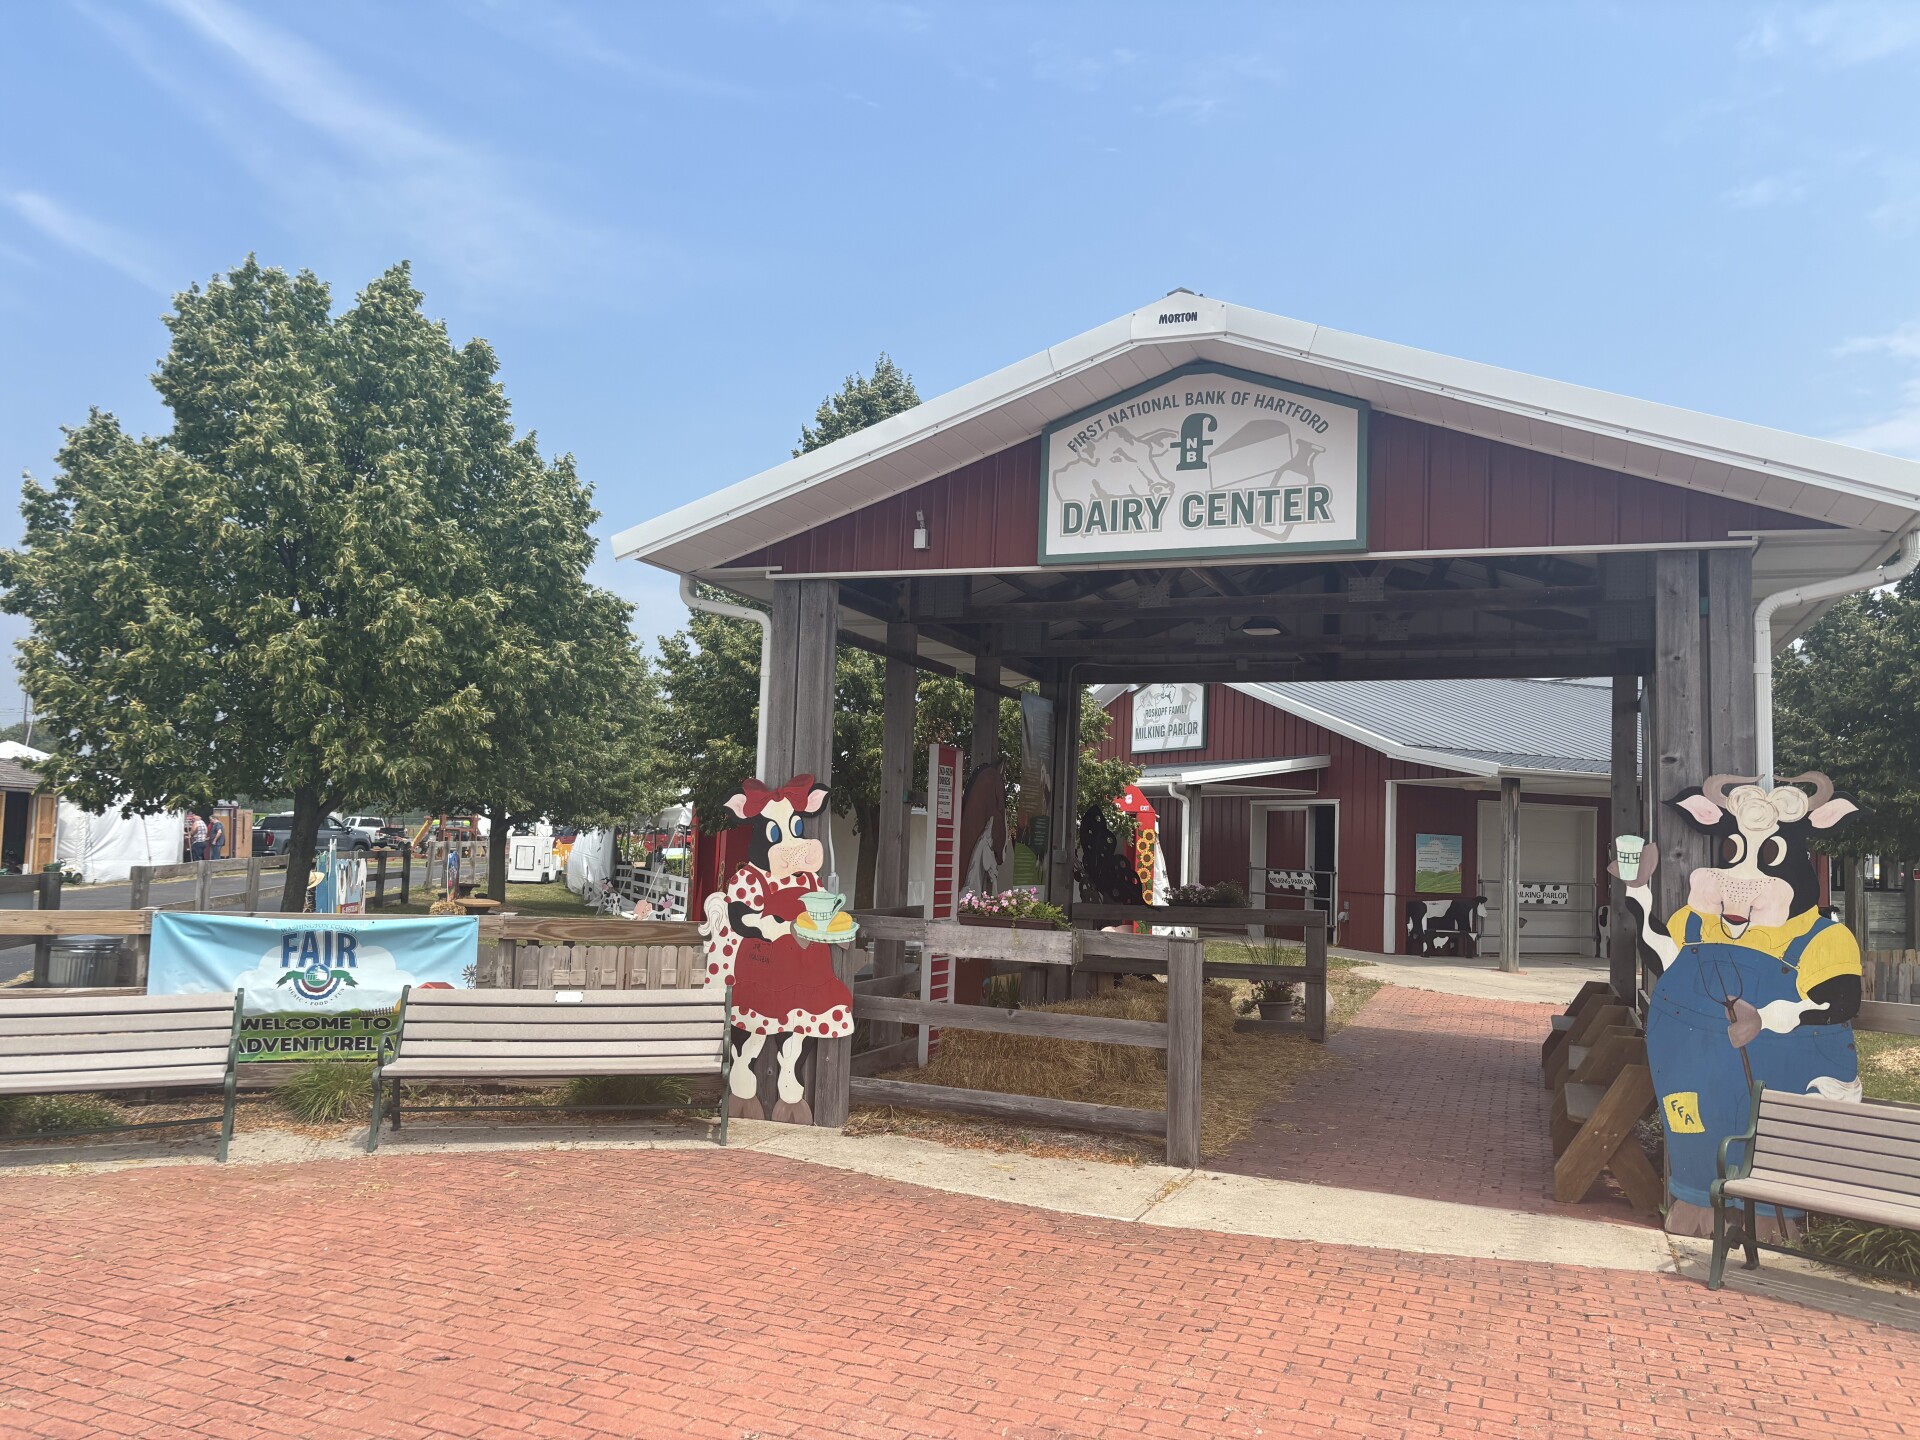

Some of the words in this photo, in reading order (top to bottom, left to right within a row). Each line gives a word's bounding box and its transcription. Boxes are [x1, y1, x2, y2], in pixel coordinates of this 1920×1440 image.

[1158, 311, 1198, 324] MORTON
[1067, 418, 1104, 453] FIRST
[1107, 394, 1179, 427] NATIONAL
[1185, 391, 1226, 406] BANK
[1231, 391, 1250, 406] OF
[1253, 393, 1329, 434] HARTFORD
[1186, 437, 1197, 449] N
[1186, 451, 1197, 462] B
[1062, 495, 1168, 535] DAIRY
[1181, 485, 1331, 528] CENTER
[1145, 706, 1168, 718] ROSKOPF
[1168, 704, 1188, 716] FAMILY
[1135, 725, 1166, 740] MILKING
[1167, 721, 1198, 737] PARLOR
[1518, 891, 1541, 899] ILKING
[1542, 891, 1567, 899] PARLOR
[280, 923, 330, 933] WASHINGTON
[330, 923, 359, 934] COUNTY
[280, 930, 359, 969] FAIR
[240, 1017, 352, 1030] WELCOME
[361, 1017, 391, 1030] TO
[1671, 1099, 1695, 1125] FFA
